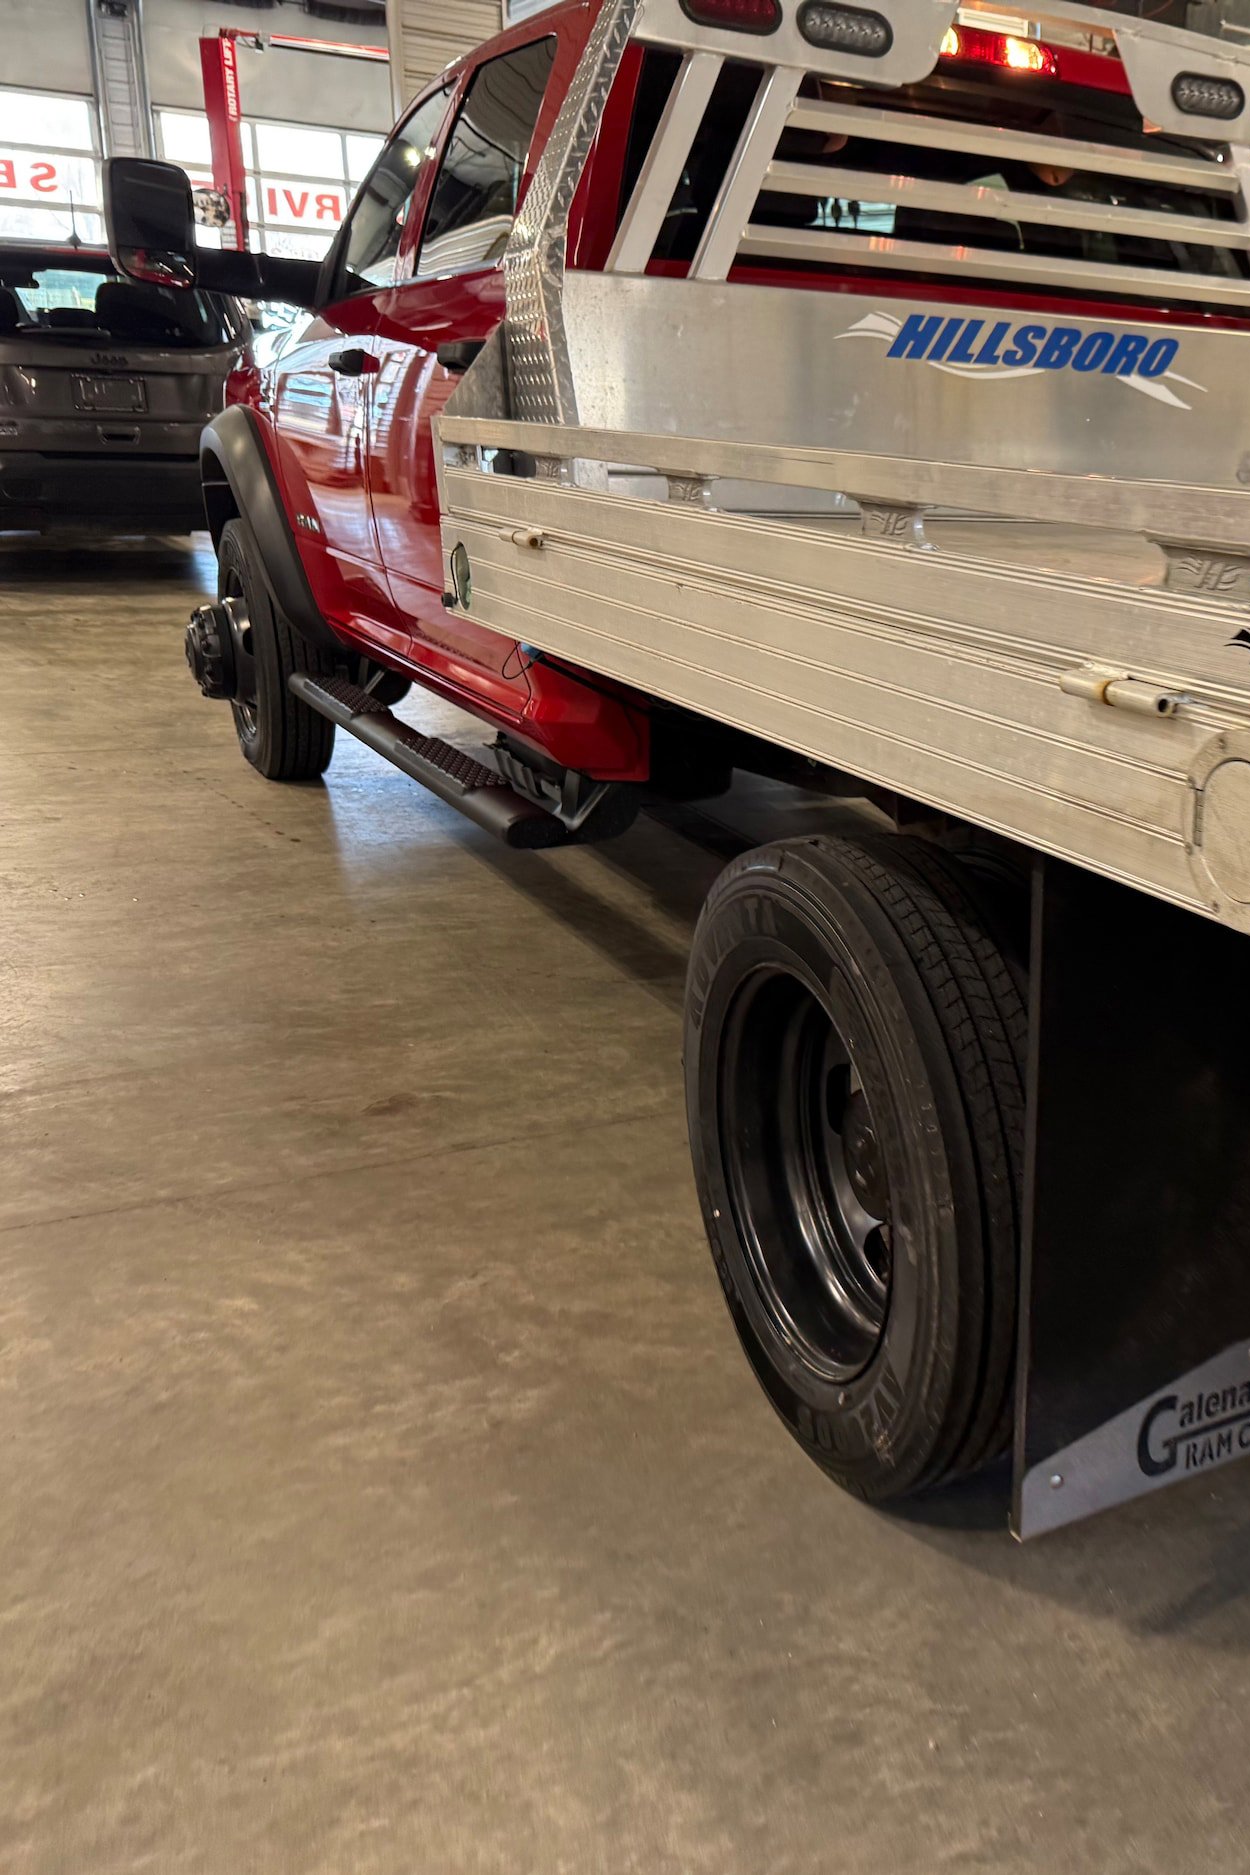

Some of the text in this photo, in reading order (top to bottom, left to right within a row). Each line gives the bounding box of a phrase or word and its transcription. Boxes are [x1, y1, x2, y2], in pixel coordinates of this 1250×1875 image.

[224, 67, 238, 116] ROTARY
[886, 314, 1179, 378] HILLSBORO
[1185, 1431, 1232, 1470] RAM
